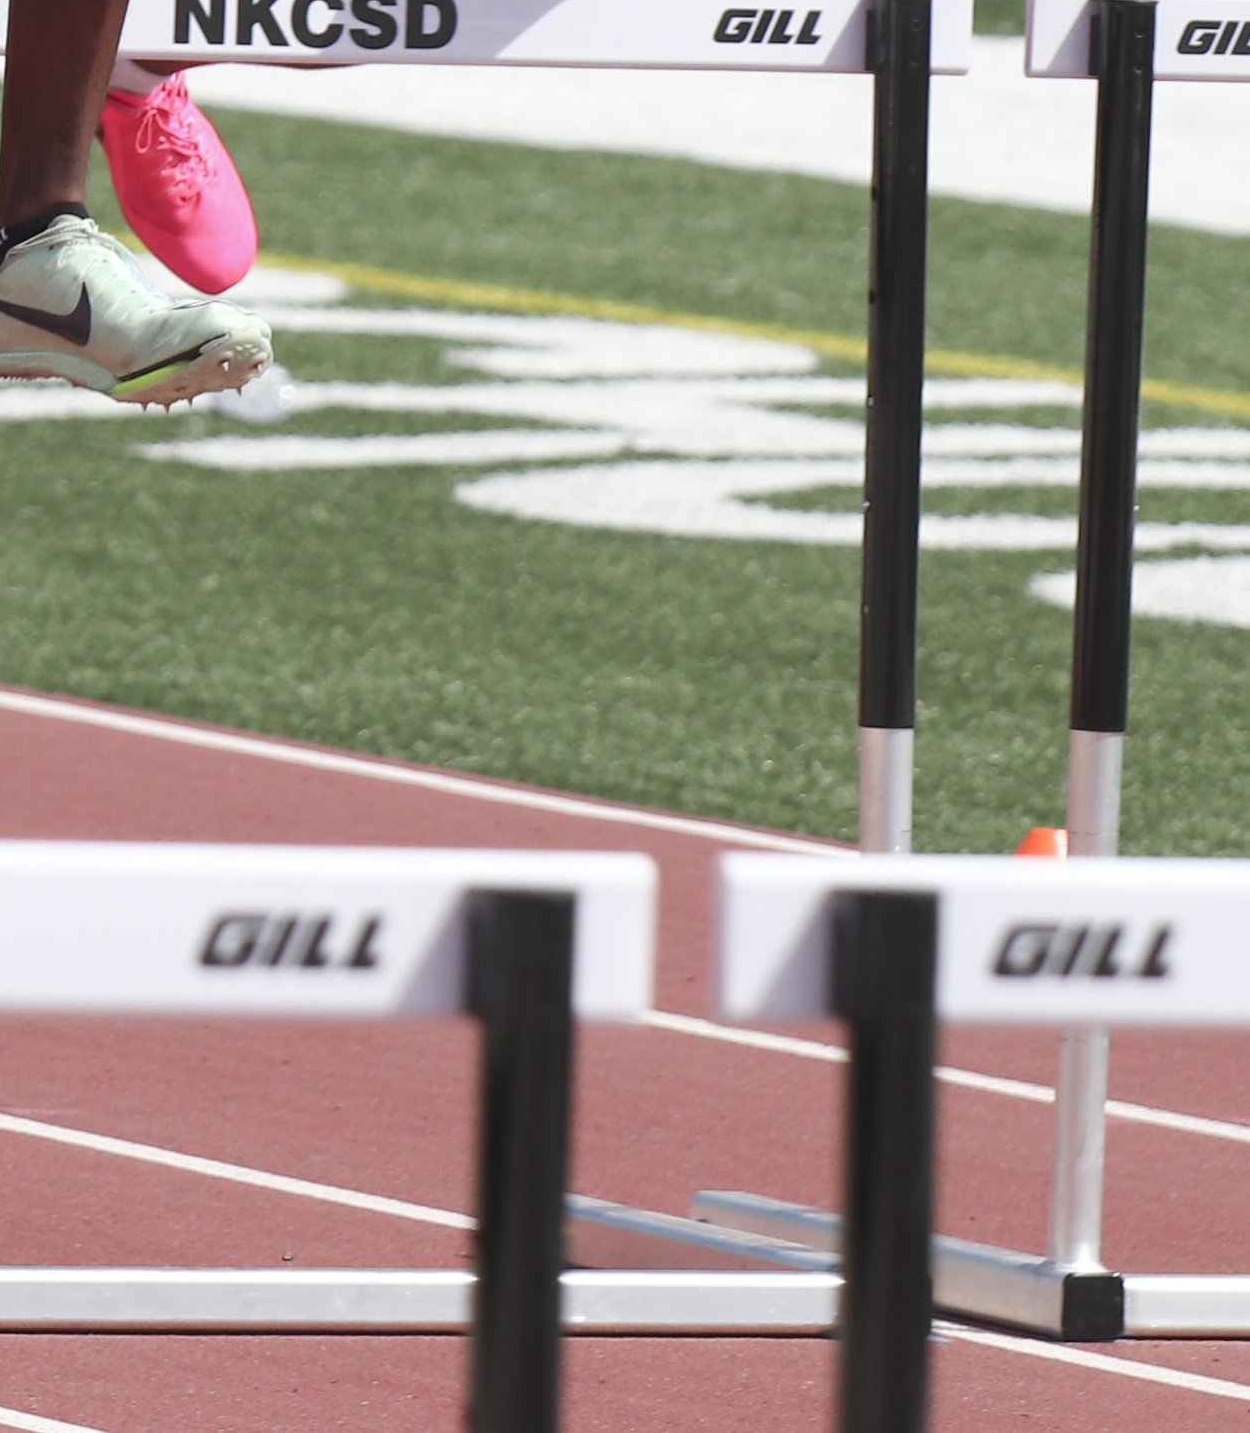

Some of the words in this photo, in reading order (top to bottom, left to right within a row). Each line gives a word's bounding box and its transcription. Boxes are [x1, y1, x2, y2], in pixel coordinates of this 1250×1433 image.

[713, 8, 822, 45] GILL
[199, 914, 380, 971] GILL
[992, 924, 1170, 980] GILL
